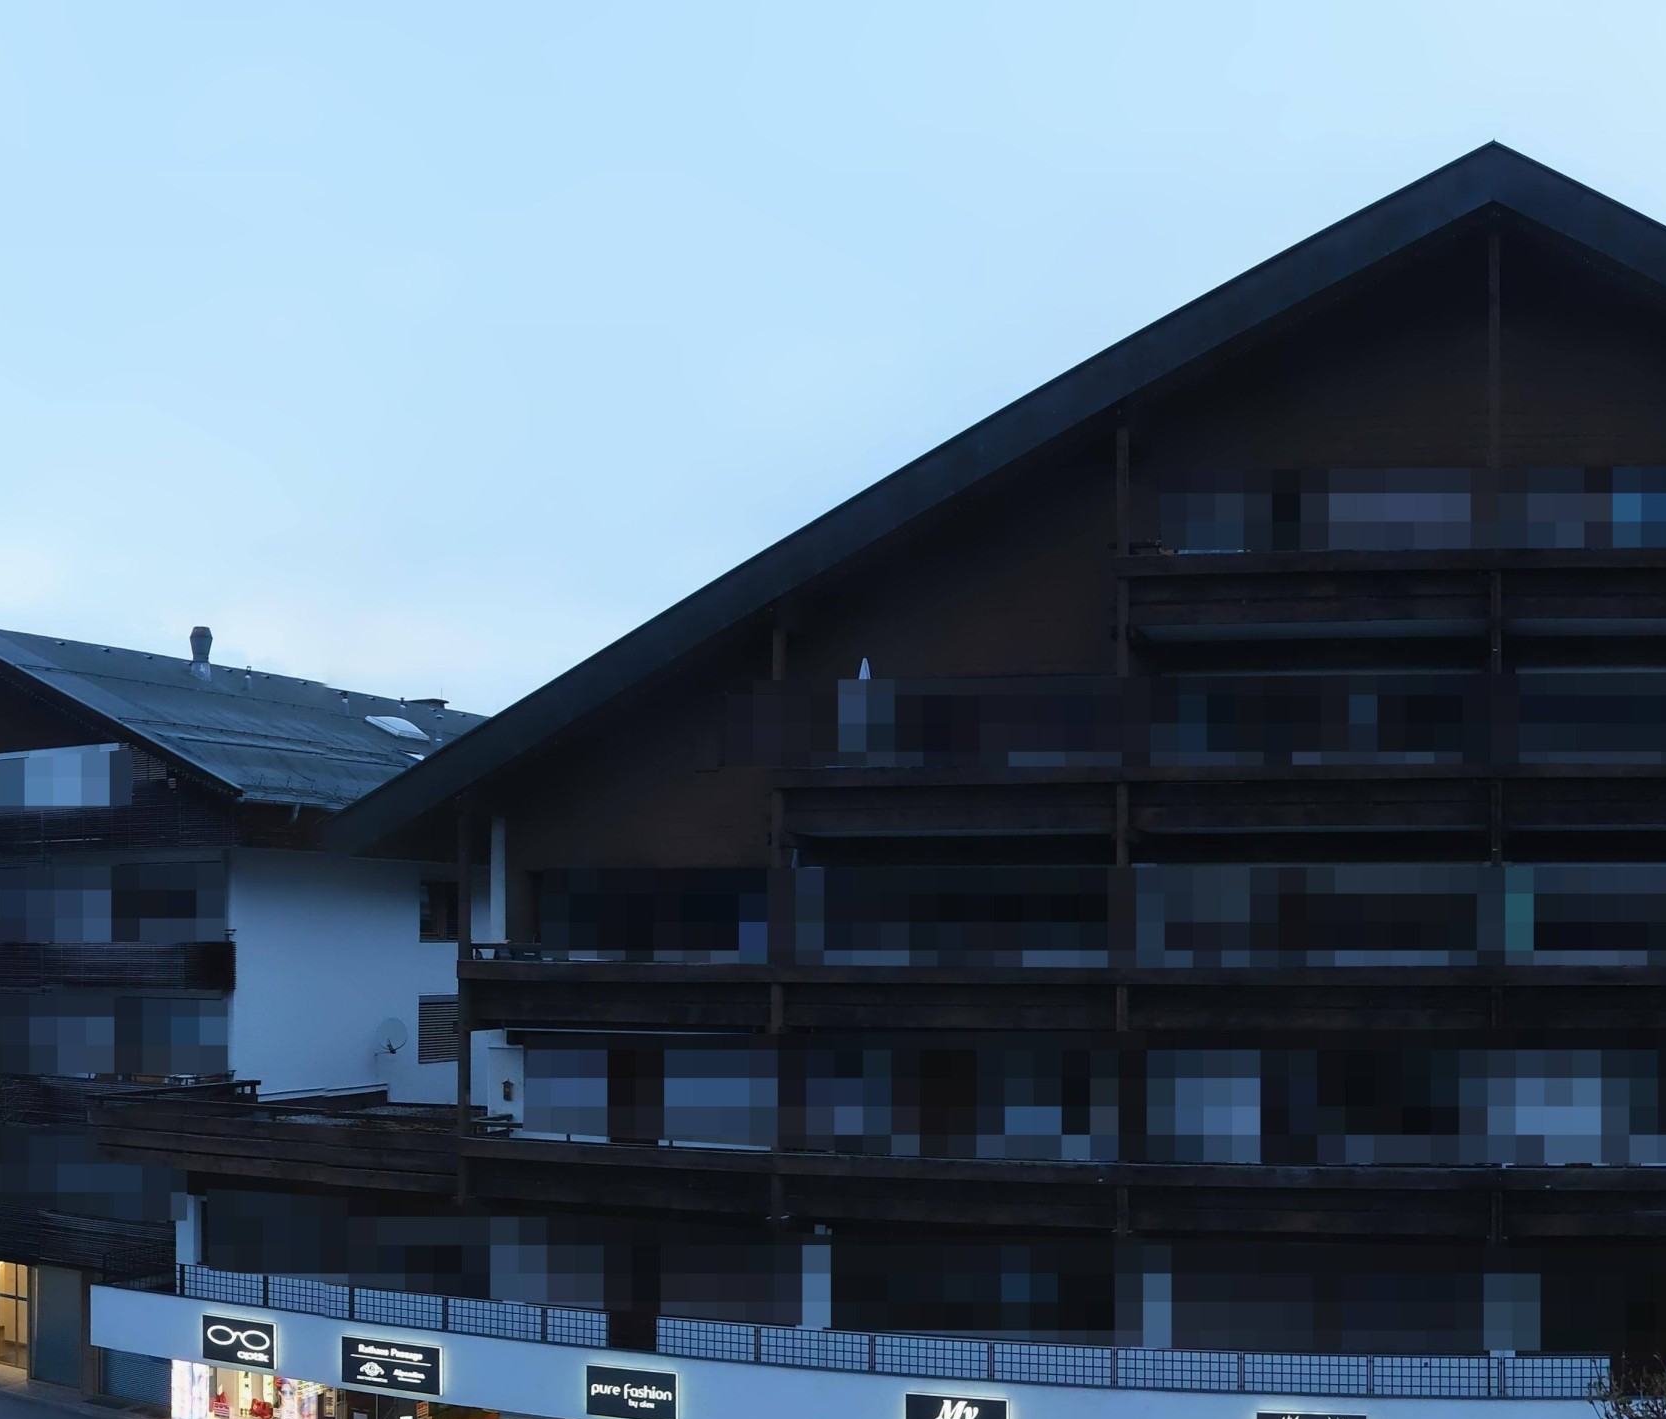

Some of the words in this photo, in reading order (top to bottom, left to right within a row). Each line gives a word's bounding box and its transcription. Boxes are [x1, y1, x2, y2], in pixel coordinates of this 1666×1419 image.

[237, 1350, 269, 1363] optik
[591, 1383, 621, 1396] pure
[624, 1383, 672, 1401] fashion
[628, 1398, 638, 1409] by
